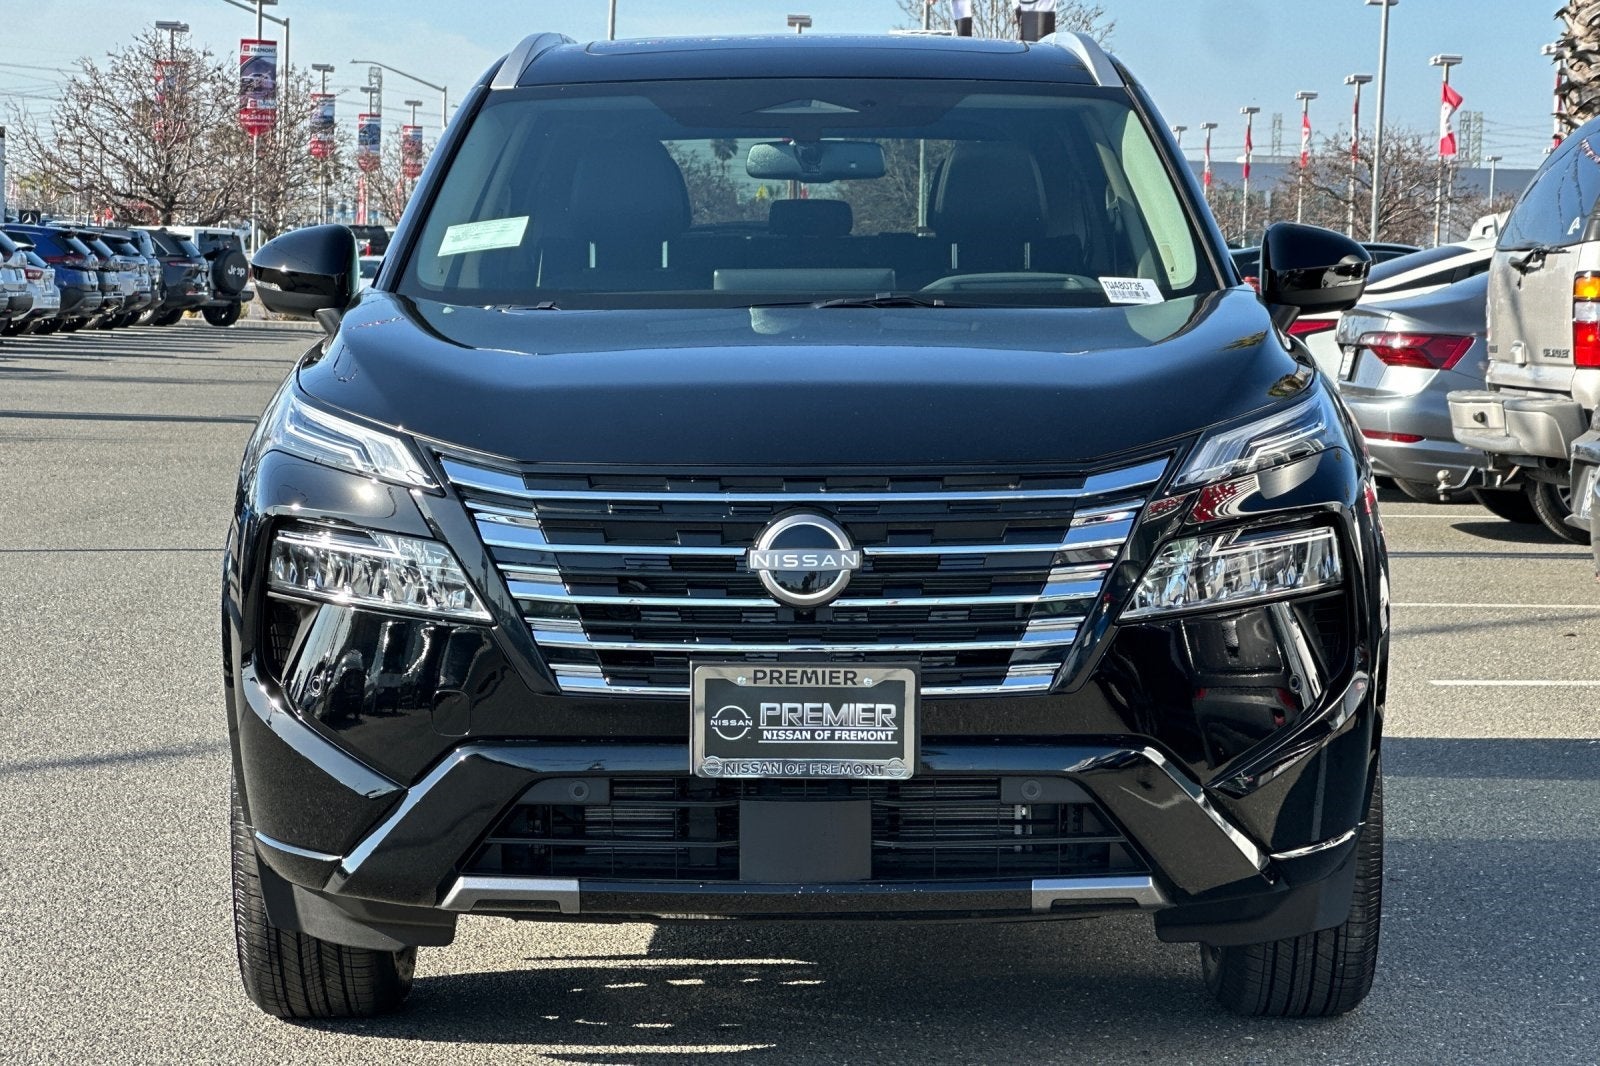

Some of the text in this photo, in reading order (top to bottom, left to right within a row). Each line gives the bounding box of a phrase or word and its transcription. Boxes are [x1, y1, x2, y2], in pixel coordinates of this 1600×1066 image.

[754, 554, 857, 568] NISSAN
[753, 669, 858, 686] PREMIER
[760, 702, 897, 728] PREMIER
[710, 719, 753, 727] NISSAN
[763, 730, 894, 741] NISSAN OF FREMONT
[724, 762, 782, 776] NISSAN
[785, 762, 809, 776] OF
[810, 763, 884, 776] FREMONT
